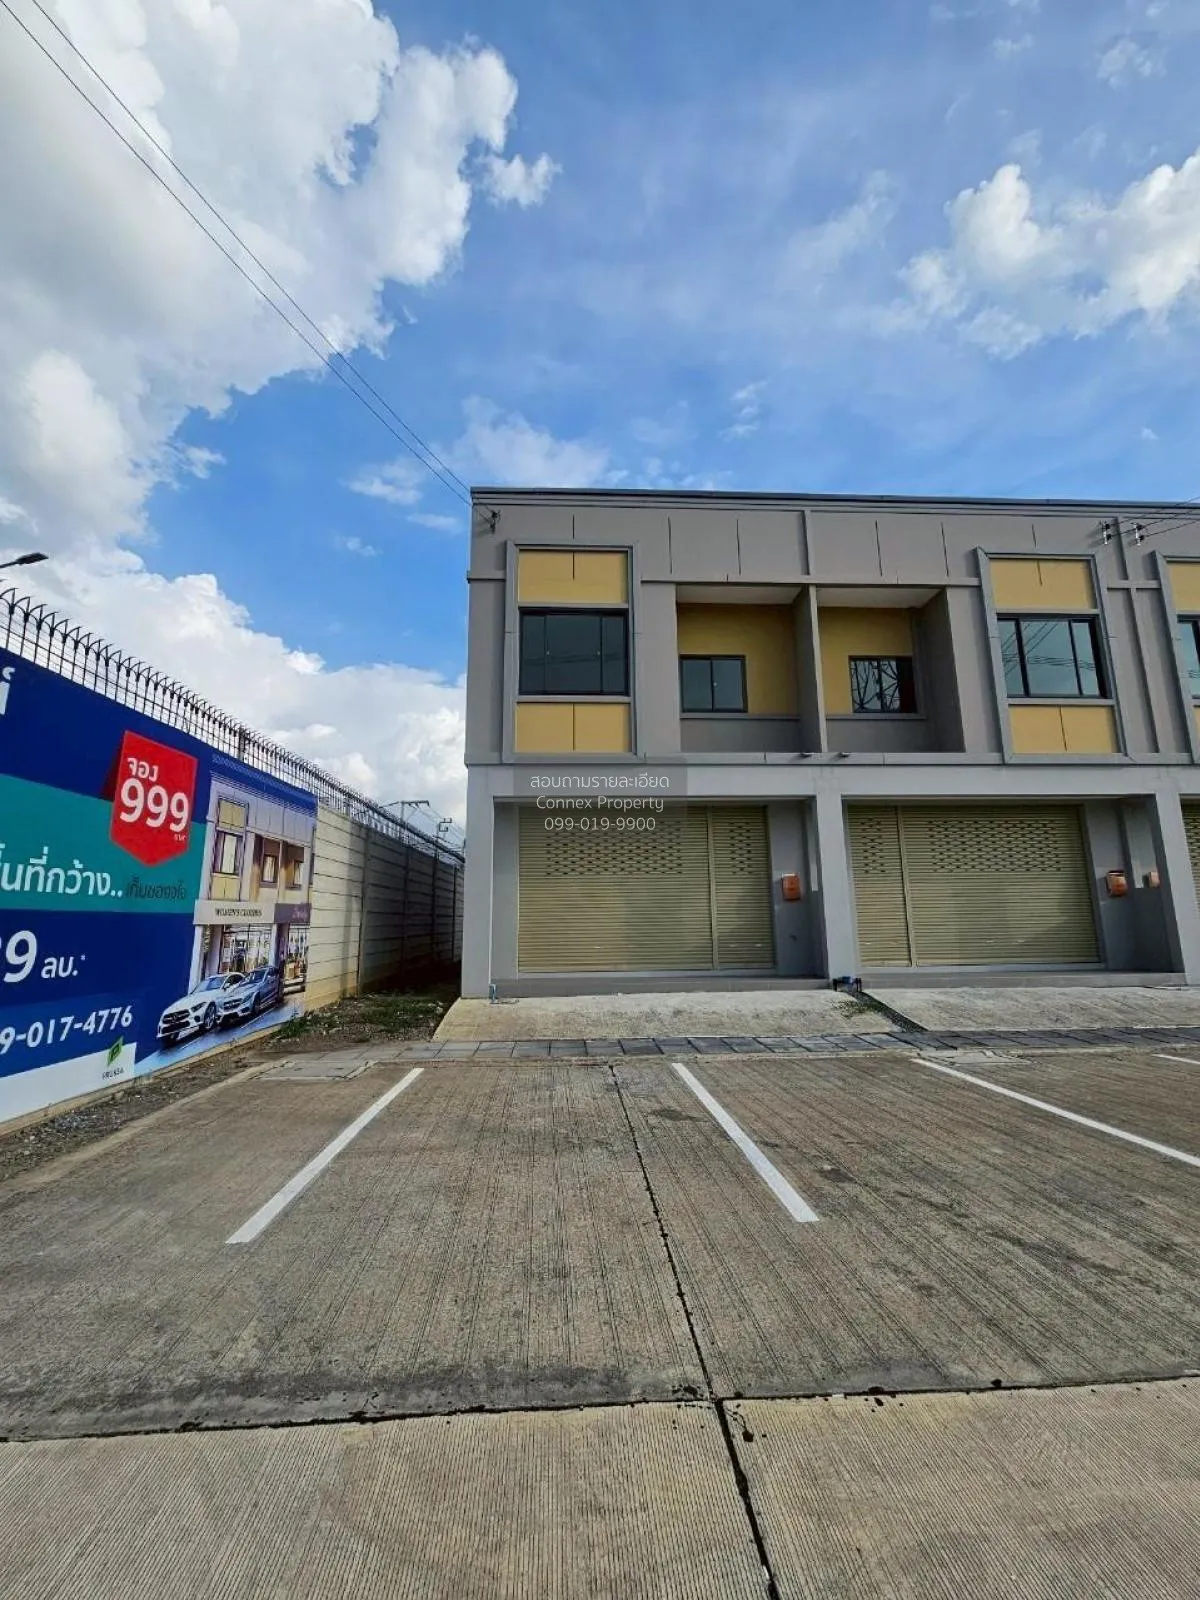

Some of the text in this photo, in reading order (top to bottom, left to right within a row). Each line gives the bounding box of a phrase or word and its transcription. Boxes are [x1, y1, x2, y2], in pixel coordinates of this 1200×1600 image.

[127, 757, 159, 782] จอง
[120, 777, 189, 832] 999
[0, 930, 38, 983] 9
[0, 1005, 133, 1055] 9-017-4776
